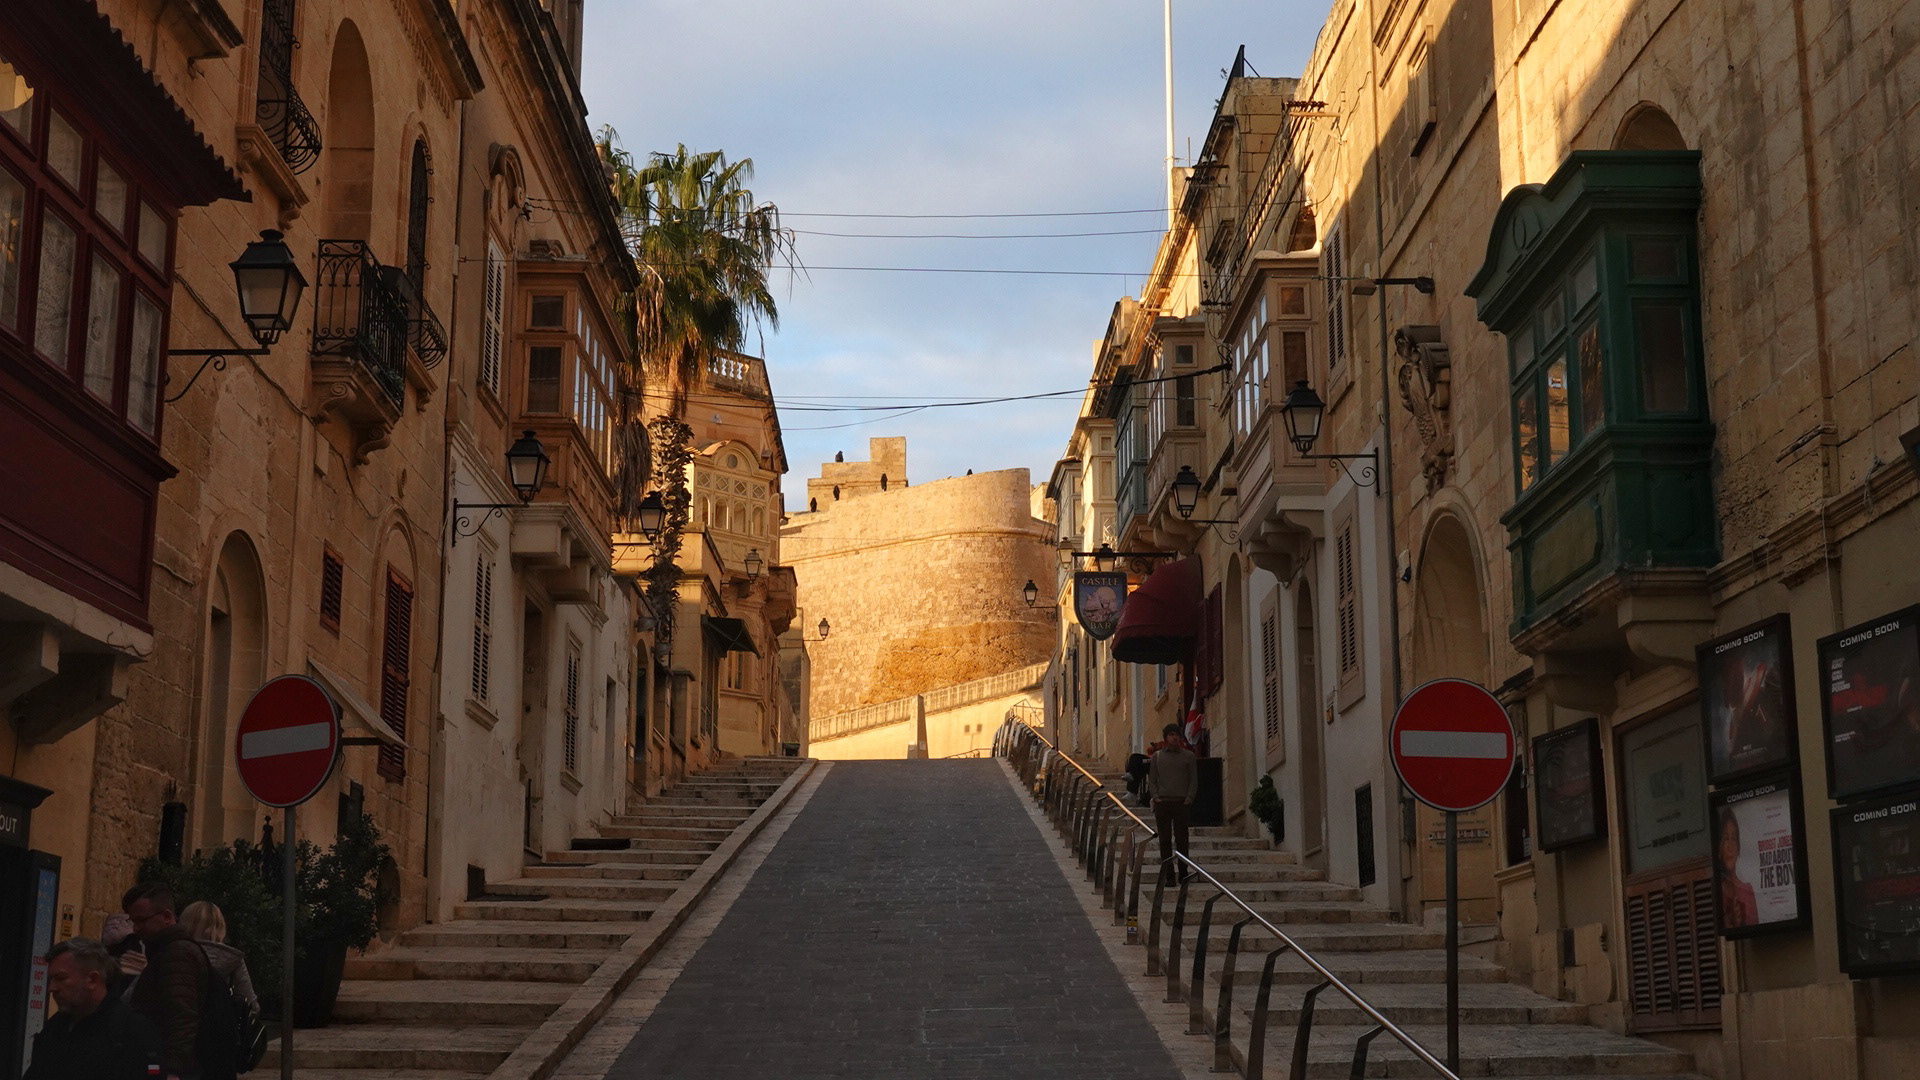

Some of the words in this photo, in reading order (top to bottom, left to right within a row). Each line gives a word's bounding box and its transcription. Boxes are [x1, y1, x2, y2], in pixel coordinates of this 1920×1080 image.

[1081, 578, 1120, 586] CASTLE
[1090, 622, 1112, 630] BAR
[1839, 631, 1873, 648] COMING
[1874, 620, 1900, 637] SOON
[1715, 638, 1742, 654] COMING
[1743, 629, 1765, 644] SOON
[1726, 788, 1754, 804] COMING
[1754, 783, 1776, 797] SOON
[1853, 808, 1888, 823] COMING
[1890, 802, 1917, 815] SOON
[0, 814, 17, 834] OUT
[1758, 837, 1776, 853] BRIDGET
[1759, 850, 1773, 868] MAD
[1760, 866, 1776, 889] THE
